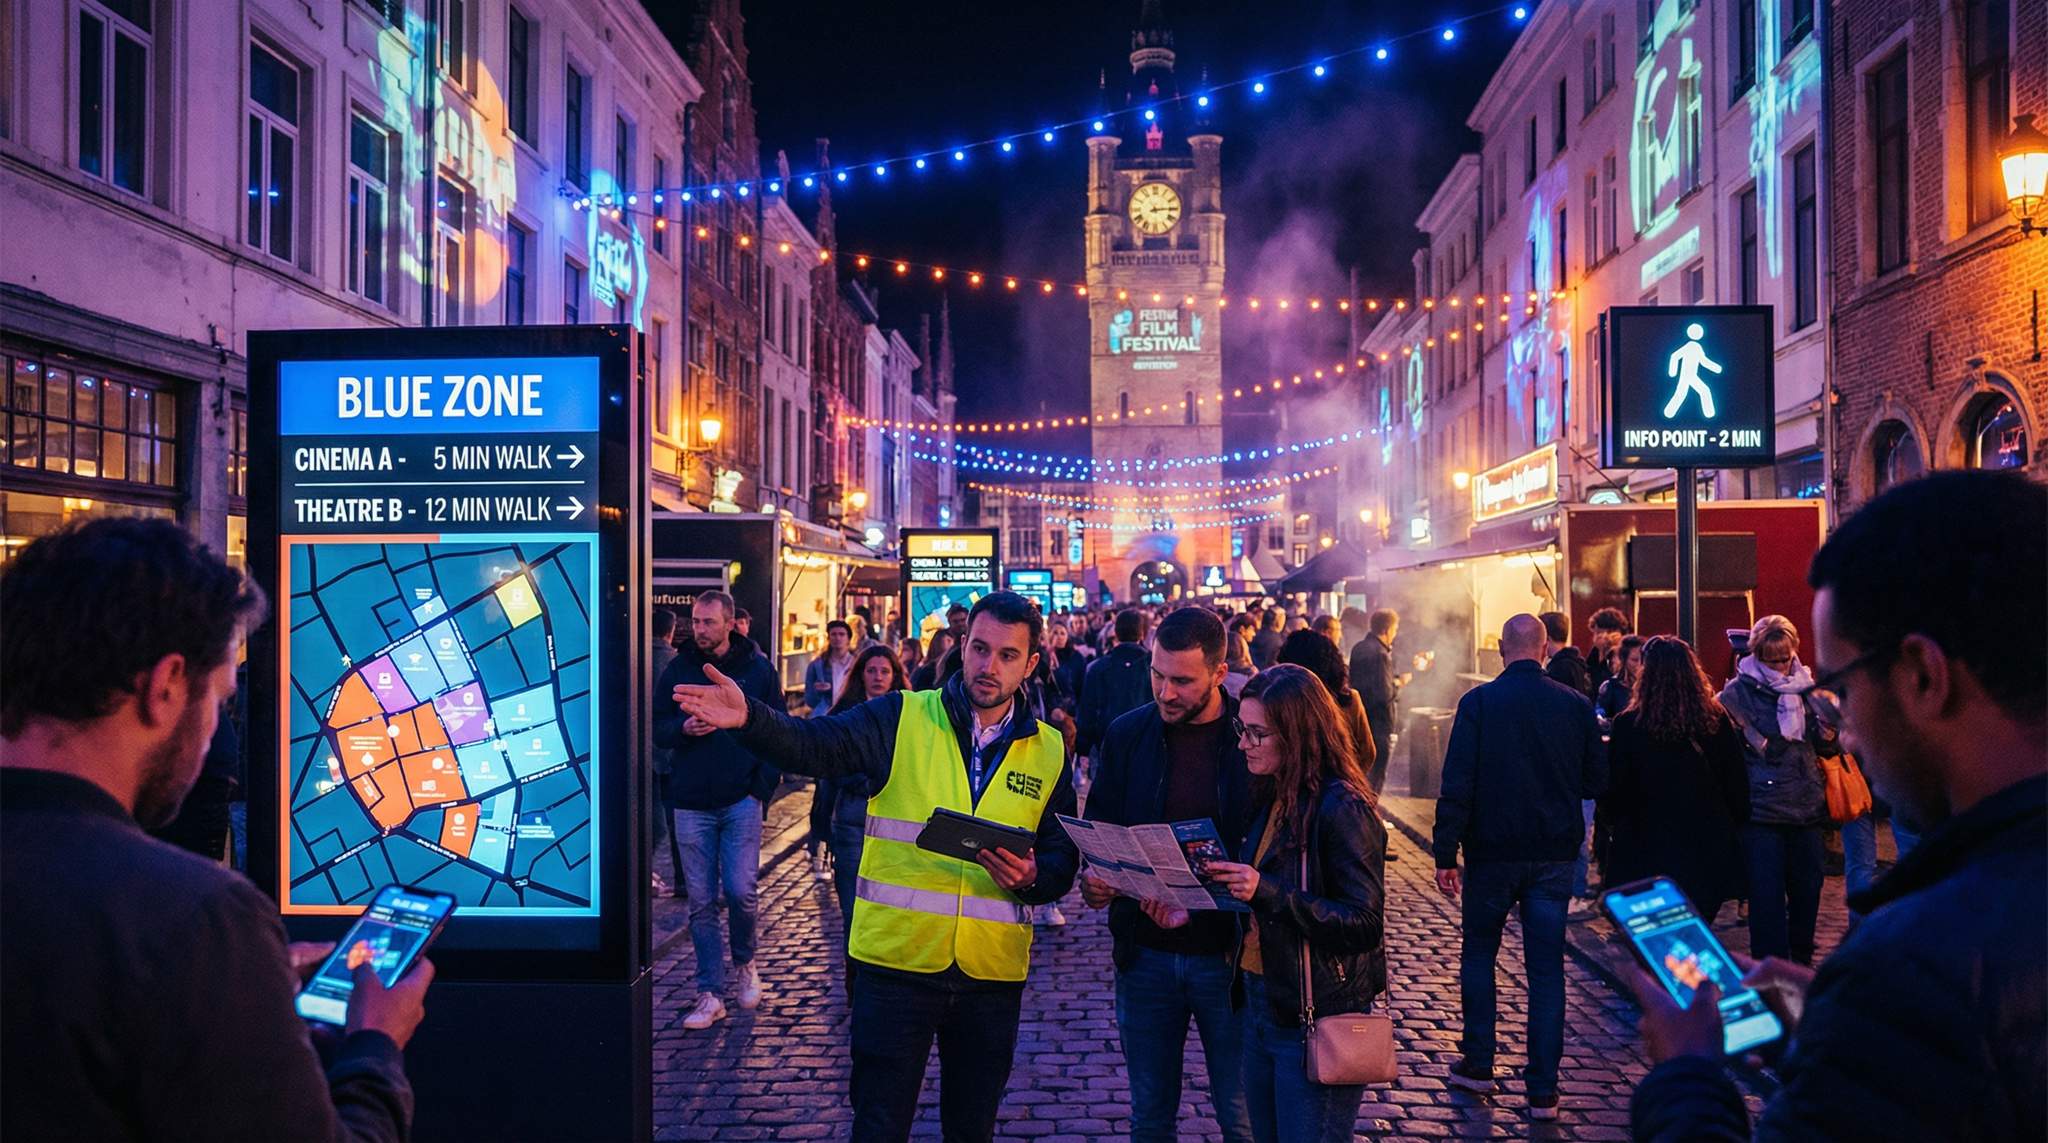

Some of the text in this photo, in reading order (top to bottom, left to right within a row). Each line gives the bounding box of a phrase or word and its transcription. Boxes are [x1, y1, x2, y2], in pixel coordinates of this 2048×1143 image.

[1140, 321, 1179, 336] FILM
[1122, 336, 1201, 352] FESTIVAL
[338, 374, 543, 418] BLUE ZONE
[1624, 429, 1660, 448] INFO
[1661, 429, 1707, 448] POINT
[1718, 429, 1730, 448] 2
[1731, 429, 1761, 448] MIN
[294, 447, 374, 472] CINEMA
[377, 446, 393, 471] A
[434, 446, 447, 470] 5
[452, 446, 490, 470] MIN
[494, 444, 552, 470] WALK
[294, 498, 384, 523] THEATRE
[388, 498, 403, 522] B
[425, 497, 447, 522] 12
[452, 497, 490, 522] MIN
[494, 496, 552, 522] WALK
